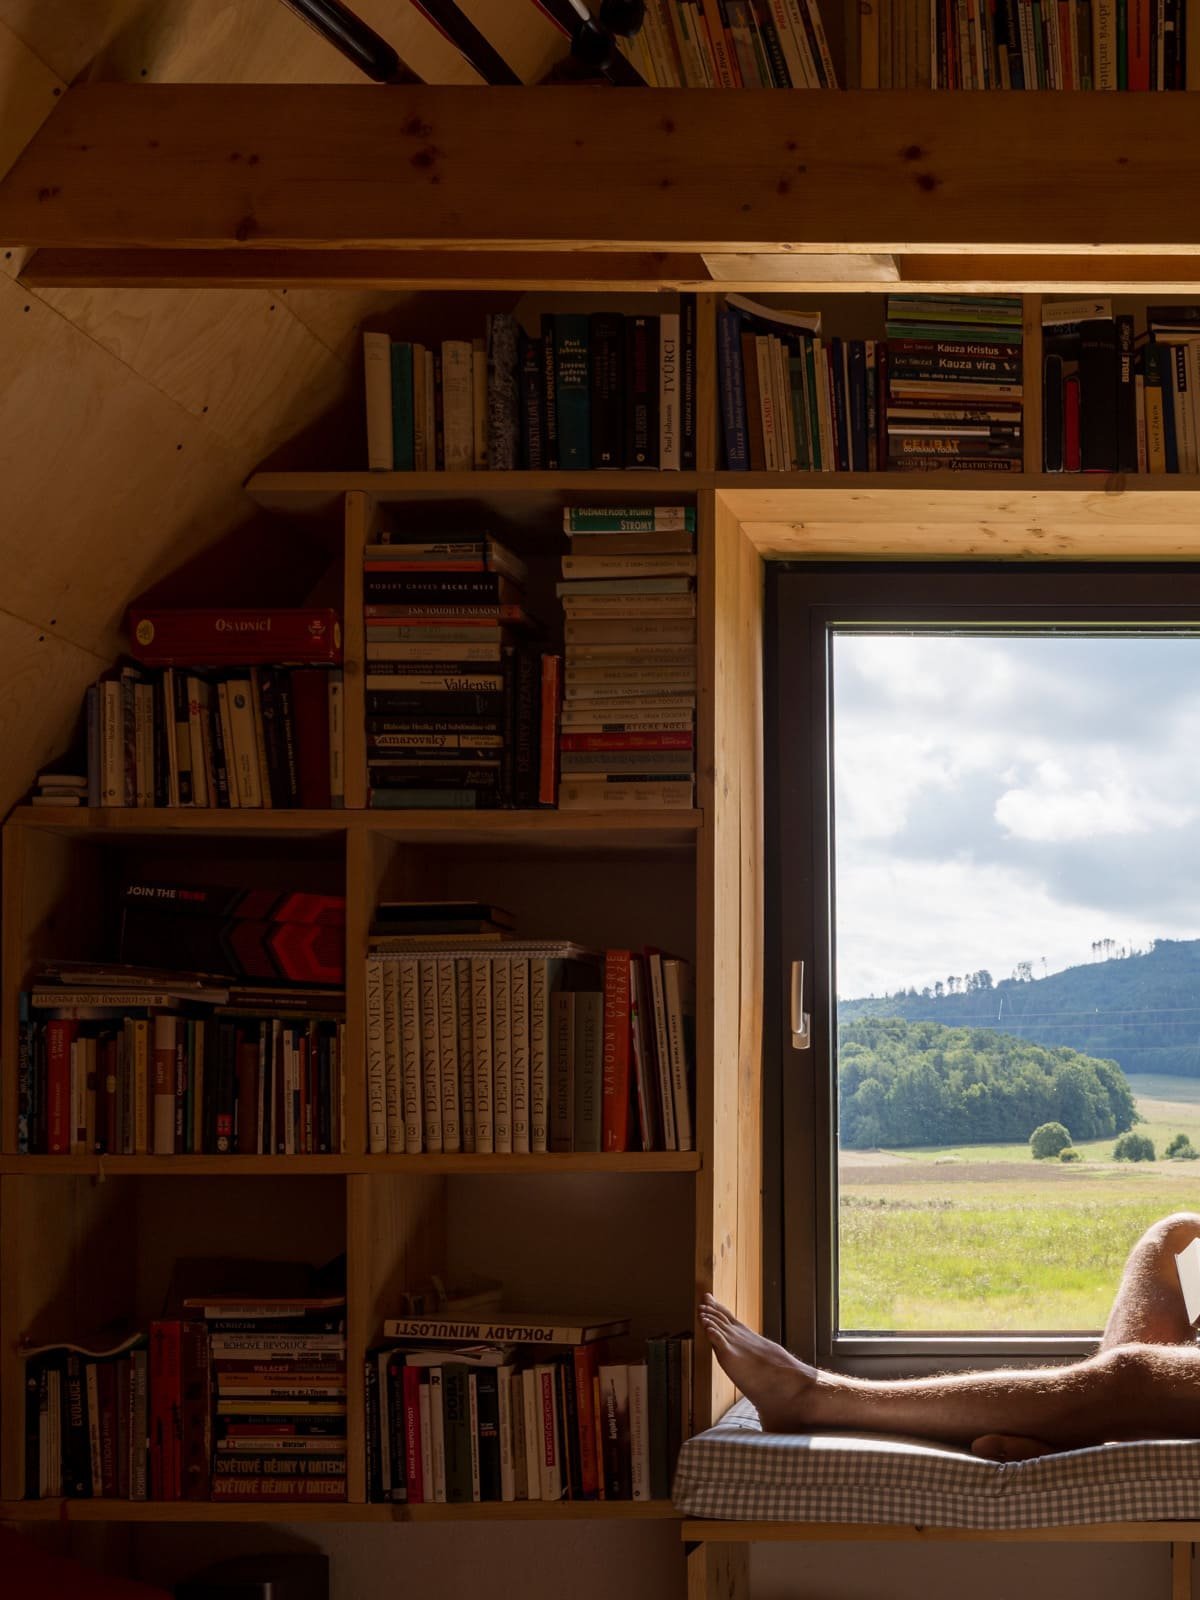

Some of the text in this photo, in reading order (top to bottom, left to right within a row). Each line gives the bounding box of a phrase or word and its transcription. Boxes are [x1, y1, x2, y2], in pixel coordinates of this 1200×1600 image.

[661, 339, 676, 393] TVŮRCI
[937, 344, 999, 355] Kauza Kristus
[939, 358, 972, 369] Kauza
[1121, 356, 1130, 383] BIBLE
[620, 520, 653, 530] STROMY
[369, 583, 402, 591] ROBERT
[444, 678, 498, 691] Valdenští
[127, 886, 155, 897] JOIN
[156, 888, 177, 899] THE
[367, 966, 380, 1041] UMENIA
[383, 970, 394, 1045] UMENIA
[402, 967, 414, 1042] UMENIA
[423, 966, 434, 1041] UMENIA
[440, 964, 453, 1039] UMENIA
[460, 966, 472, 1041] UMENIA
[475, 966, 487, 1041] UMENIA
[495, 967, 507, 1042] UMENIA
[512, 963, 524, 1038] UMENIA
[532, 966, 544, 1042] UMENIA
[604, 954, 617, 1018] GALERIE
[616, 954, 627, 1004] PRAZE
[559, 1015, 568, 1073] ESTETIKY
[583, 1015, 593, 1075] ESTETIKY
[369, 1048, 383, 1113] DEJINY
[386, 1053, 397, 1118] DEJINY
[404, 1048, 417, 1114] DEJINY
[425, 1047, 437, 1113] DEJINY
[443, 1046, 455, 1111] DEJINY
[462, 1048, 474, 1113] DEJINY
[477, 1046, 489, 1113] DEJINY
[496, 1048, 508, 1114] DEJINY
[514, 1046, 525, 1110] DEJINY
[533, 1048, 544, 1114] DEJINY
[263, 1340, 307, 1350] REVOLUCE
[395, 1323, 553, 1341] POKLADY MINULOSTI
[70, 1380, 82, 1427] EVOLUCE
[215, 1478, 345, 1494] SVĚTOVÉ DĚJINY V DATECH
[216, 1458, 345, 1473] SVĚTOVÉ DĚJINY V DATECH
